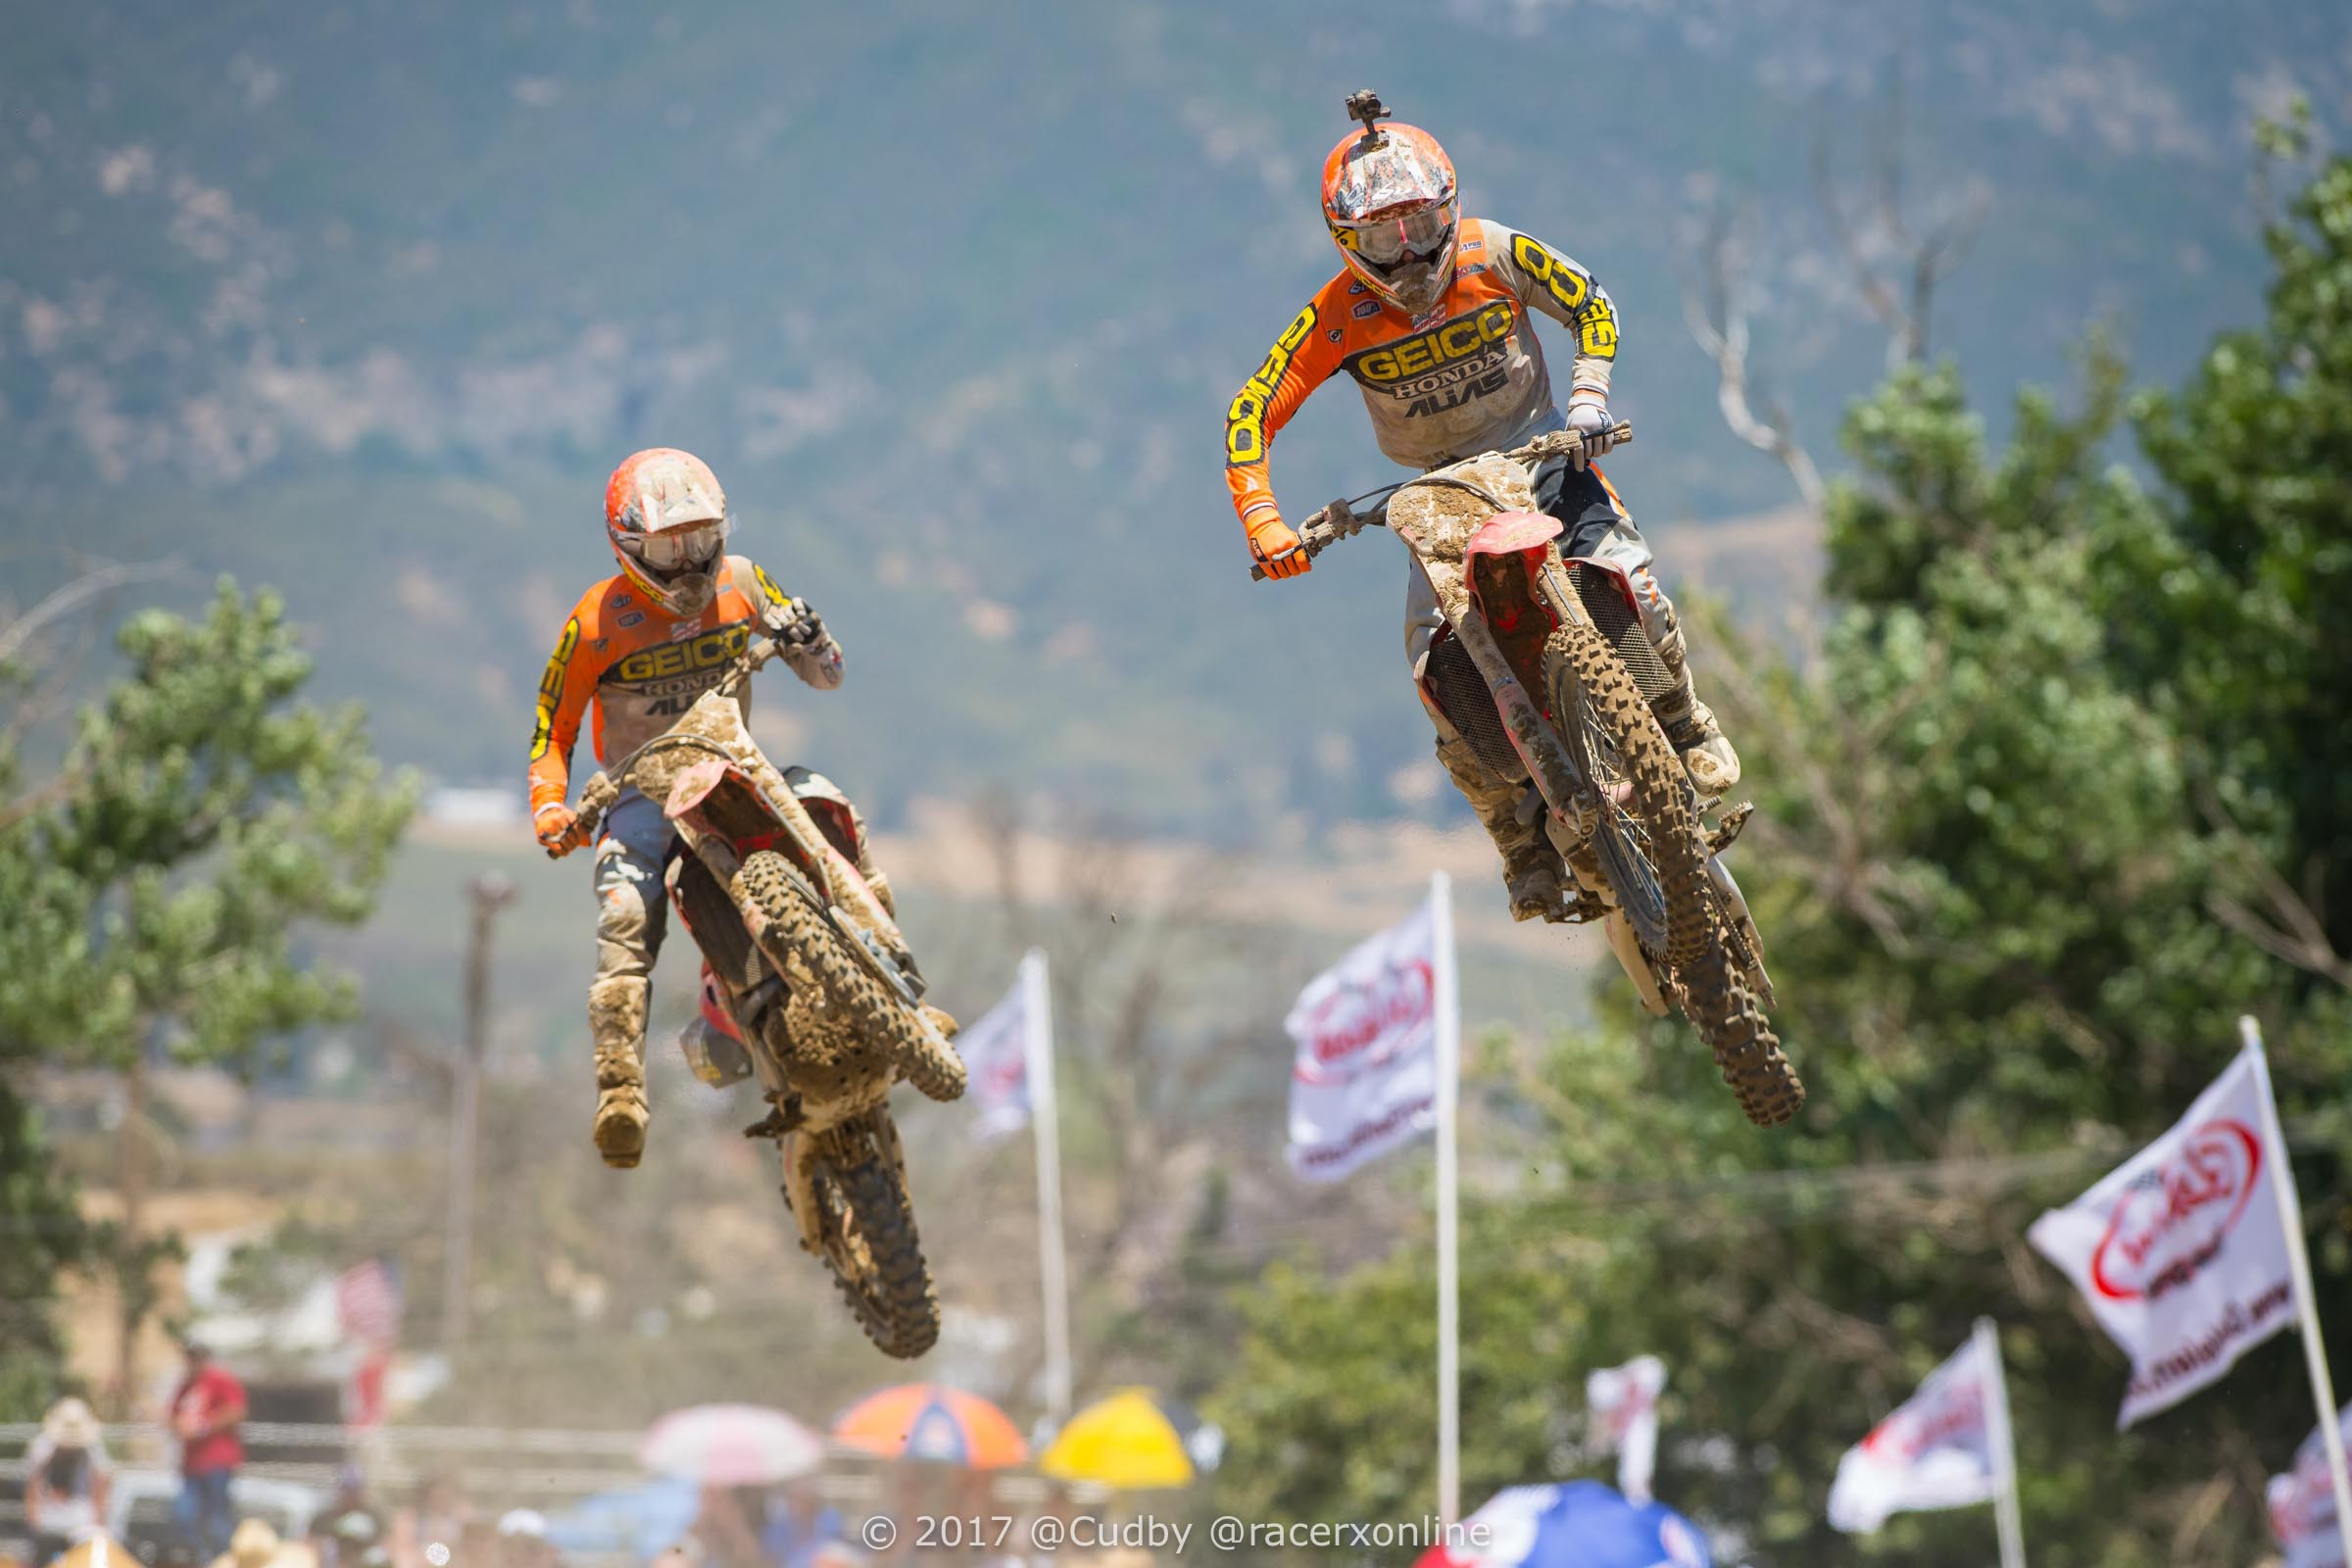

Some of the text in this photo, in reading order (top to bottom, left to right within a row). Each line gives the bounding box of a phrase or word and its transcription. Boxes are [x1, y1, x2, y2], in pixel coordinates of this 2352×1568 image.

[1358, 304, 1512, 380] GEICO
[1227, 305, 1317, 466] GEICO
[1392, 350, 1508, 400] HONDA
[619, 625, 750, 680] GEICO
[642, 672, 725, 696] HOND
